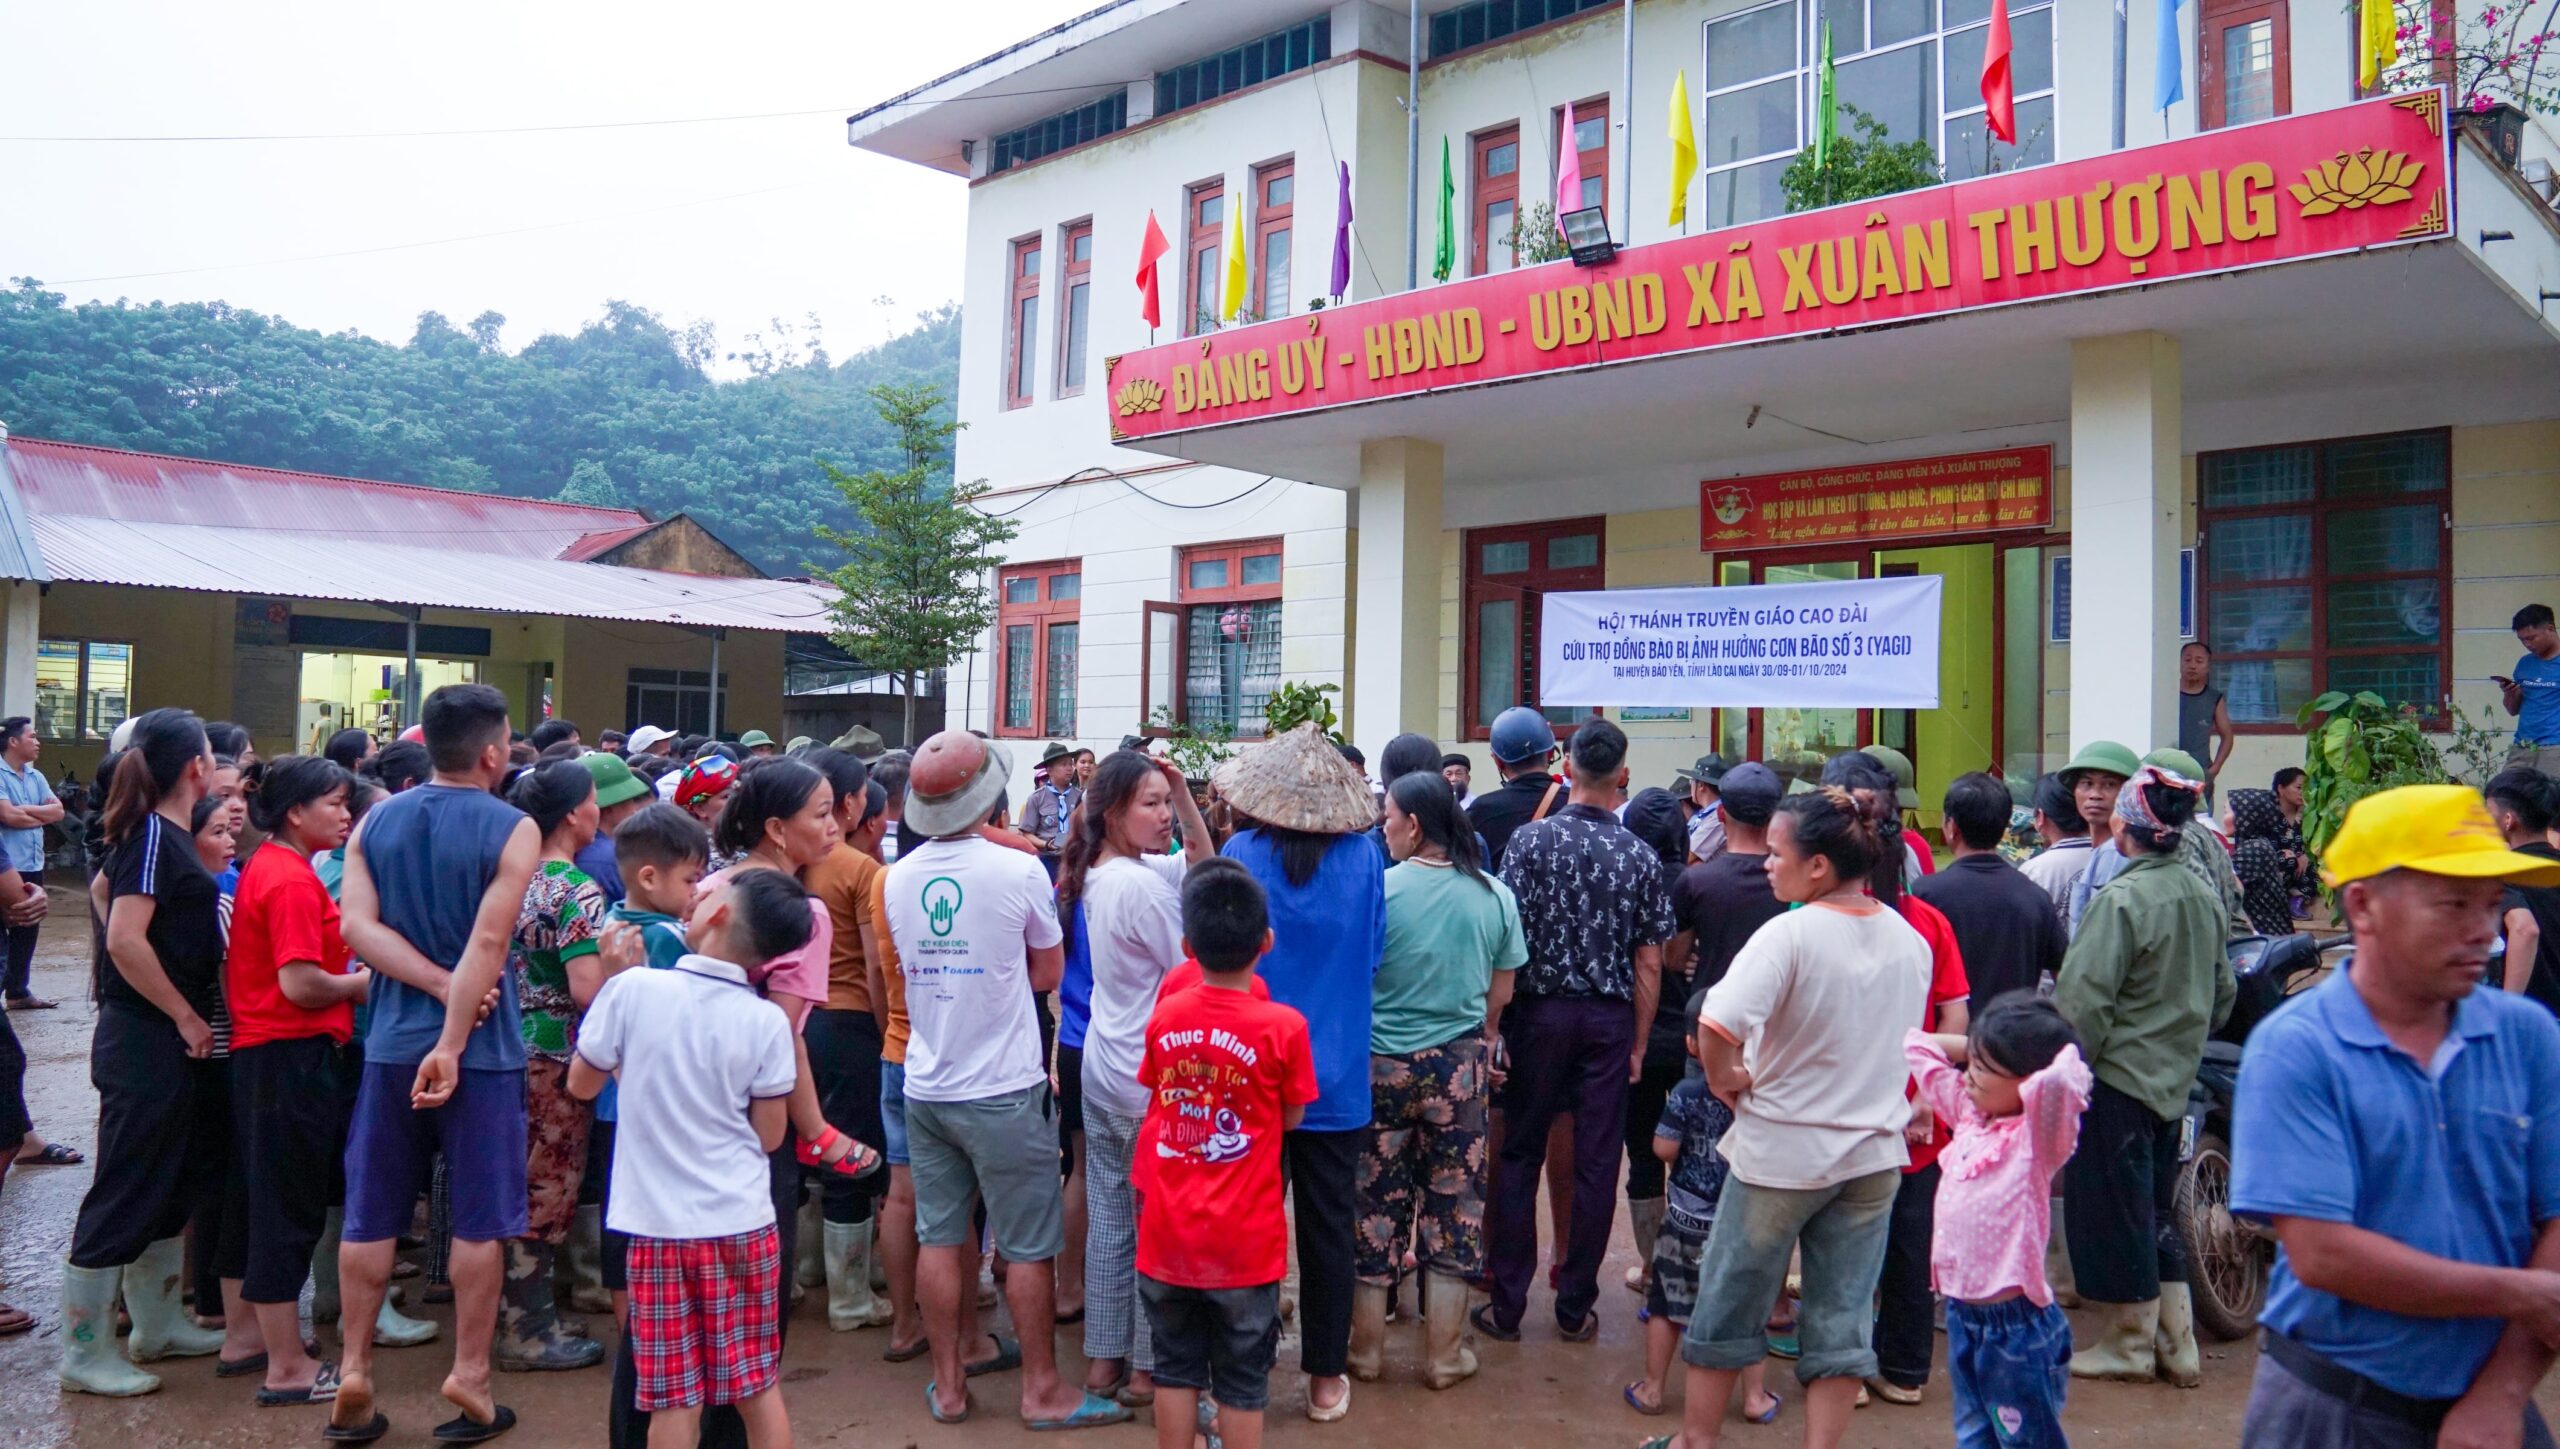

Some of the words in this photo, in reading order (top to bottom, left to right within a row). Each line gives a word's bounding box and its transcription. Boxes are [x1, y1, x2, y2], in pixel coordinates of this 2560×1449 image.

[1172, 341, 1272, 415] ĐẢNG
[1279, 317, 1328, 395] UỶ
[1364, 306, 1485, 380] HĐND
[1528, 272, 1667, 352] UBND
[1684, 241, 1764, 328] XÃ
[1777, 213, 1952, 314] XUÂN
[1967, 161, 2279, 276] THƯỢNG
[1818, 474, 1843, 487] CÔNG
[1876, 466, 1904, 481] ĐẢNG
[1906, 463, 1928, 477] VIÊN
[1930, 461, 1945, 475] XÃ
[1948, 459, 1976, 473] XUÂN
[1979, 456, 2021, 472] THƯỢNG
[1763, 501, 1778, 524] HỌC
[1780, 497, 1794, 523] TẬP
[1796, 495, 1806, 518] VÀ
[1808, 493, 1825, 517] LÀM
[1826, 496, 1846, 515] THEO
[1890, 489, 1907, 513] ĐẠO
[1930, 483, 1959, 505] PHONG
[1961, 480, 1984, 503] CÁCH
[1986, 474, 1999, 500] HỒ
[2000, 475, 2015, 499] CHÍ
[2017, 476, 2042, 498] MINH
[1880, 517, 1898, 530] cho
[1972, 509, 1992, 522] cho
[1598, 612, 1626, 634] HỘI
[1629, 609, 1682, 629] THÁNH
[1686, 606, 1750, 628] TRUYỀN
[1754, 604, 1795, 626] GIÁO
[1799, 607, 1834, 624] CAO
[1839, 602, 1868, 623] ĐÀI
[1563, 639, 1585, 661] CỨU
[1588, 641, 1611, 664] TRỢ
[1613, 636, 1646, 660] ĐỒNG
[1649, 637, 1673, 660] BÀO
[1676, 640, 1689, 663] BỊ
[1691, 634, 1718, 659] ẢNH
[1722, 634, 1766, 658] HƯỞNG
[1770, 636, 1797, 658] CƠN
[1800, 634, 1828, 657] BÃO
[1832, 631, 1852, 656] SỐ
[1854, 636, 1863, 656] 3
[1867, 635, 1912, 656] (YAGI)
[1613, 665, 1624, 679] TẠI
[1626, 664, 1650, 679] HUYỆN
[1651, 662, 1667, 678] BẢO
[1669, 663, 1686, 678] YÊN,
[1687, 662, 1706, 677] TỈNH
[1707, 662, 1723, 677] LÀO
[1724, 665, 1737, 677] CAI
[1738, 662, 1760, 677] NGÀY
[1761, 663, 1847, 677] 30/09-01/10/2024
[923, 967, 939, 975] EVN
[949, 967, 985, 975] DAIKIN
[1158, 1028, 1204, 1052] Thục
[1209, 1027, 1258, 1067] Minh
